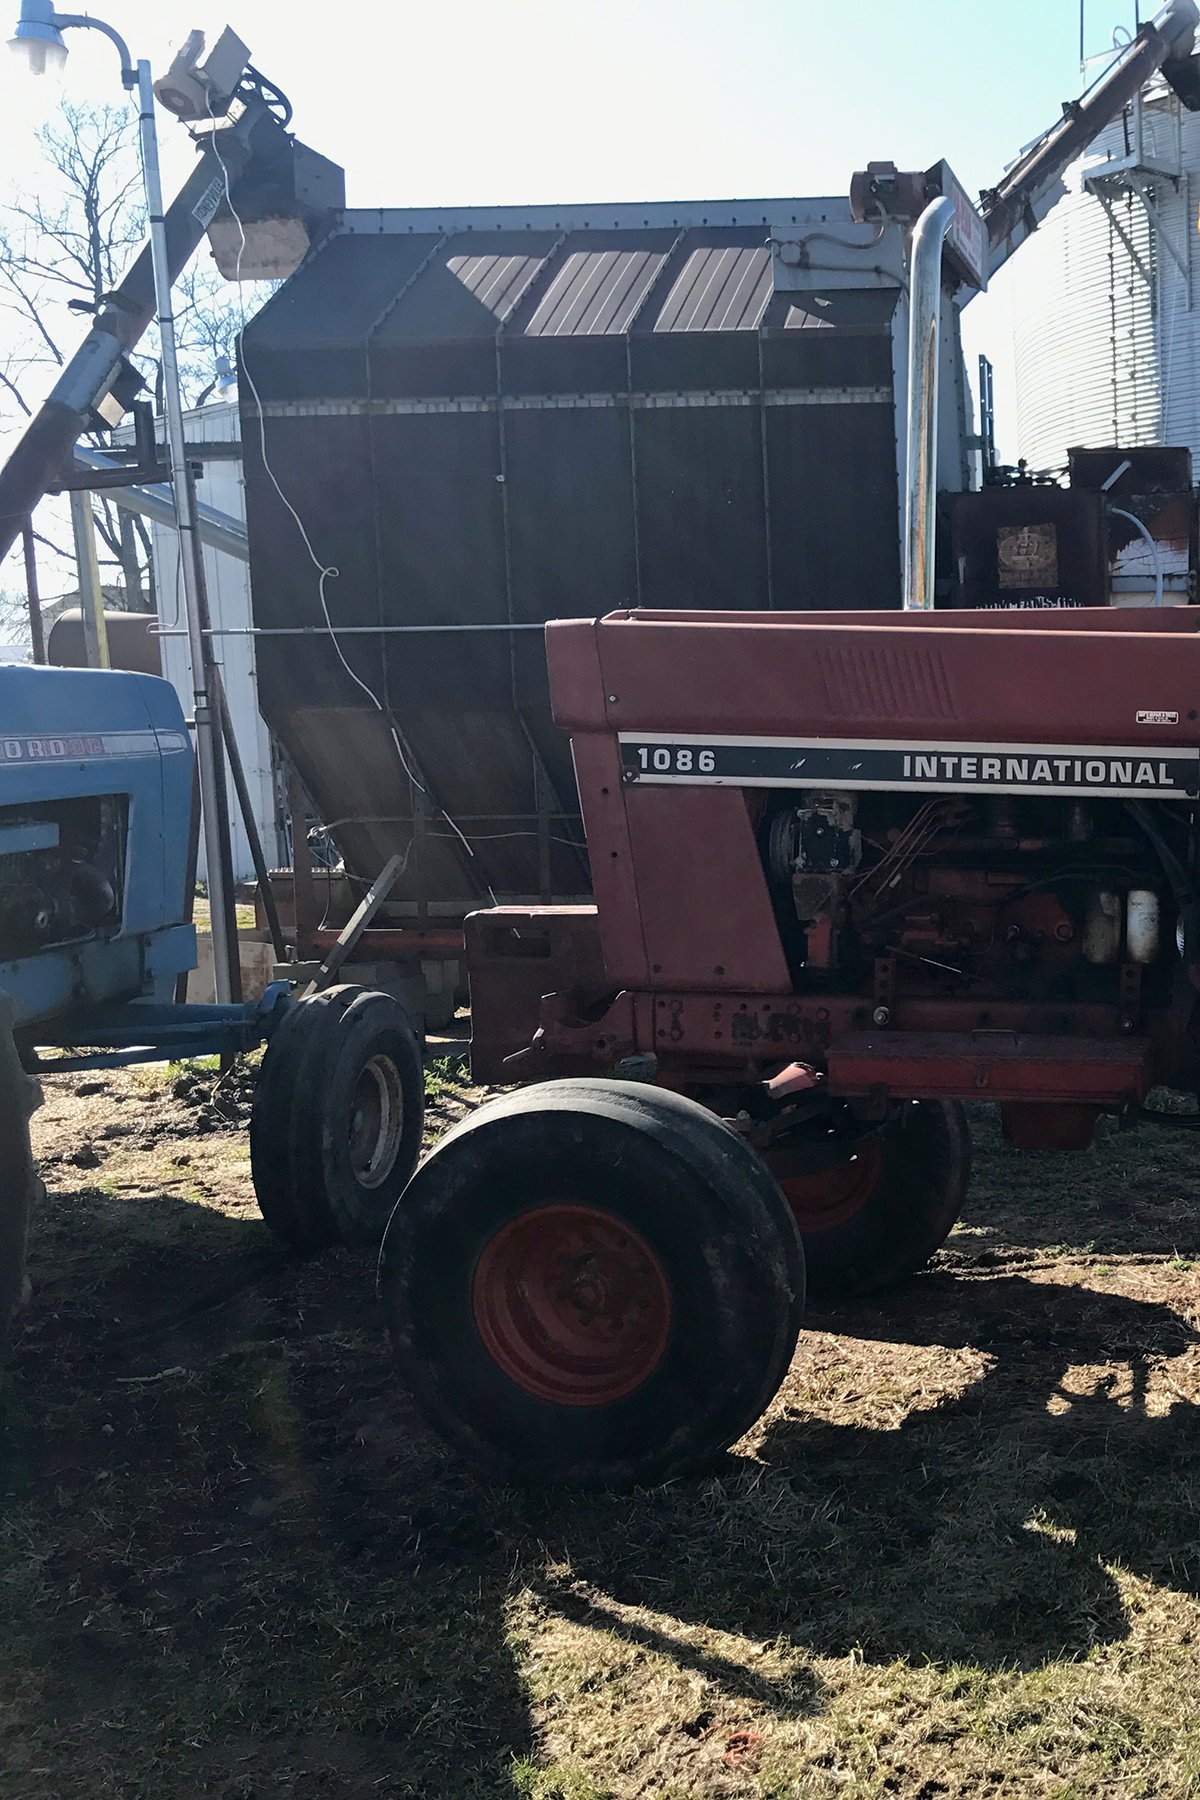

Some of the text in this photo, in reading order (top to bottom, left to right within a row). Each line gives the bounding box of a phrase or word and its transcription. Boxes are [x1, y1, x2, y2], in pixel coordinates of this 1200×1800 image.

[3, 739, 64, 758] ORD
[637, 747, 1174, 785] 1086 INTERNATIONAL
